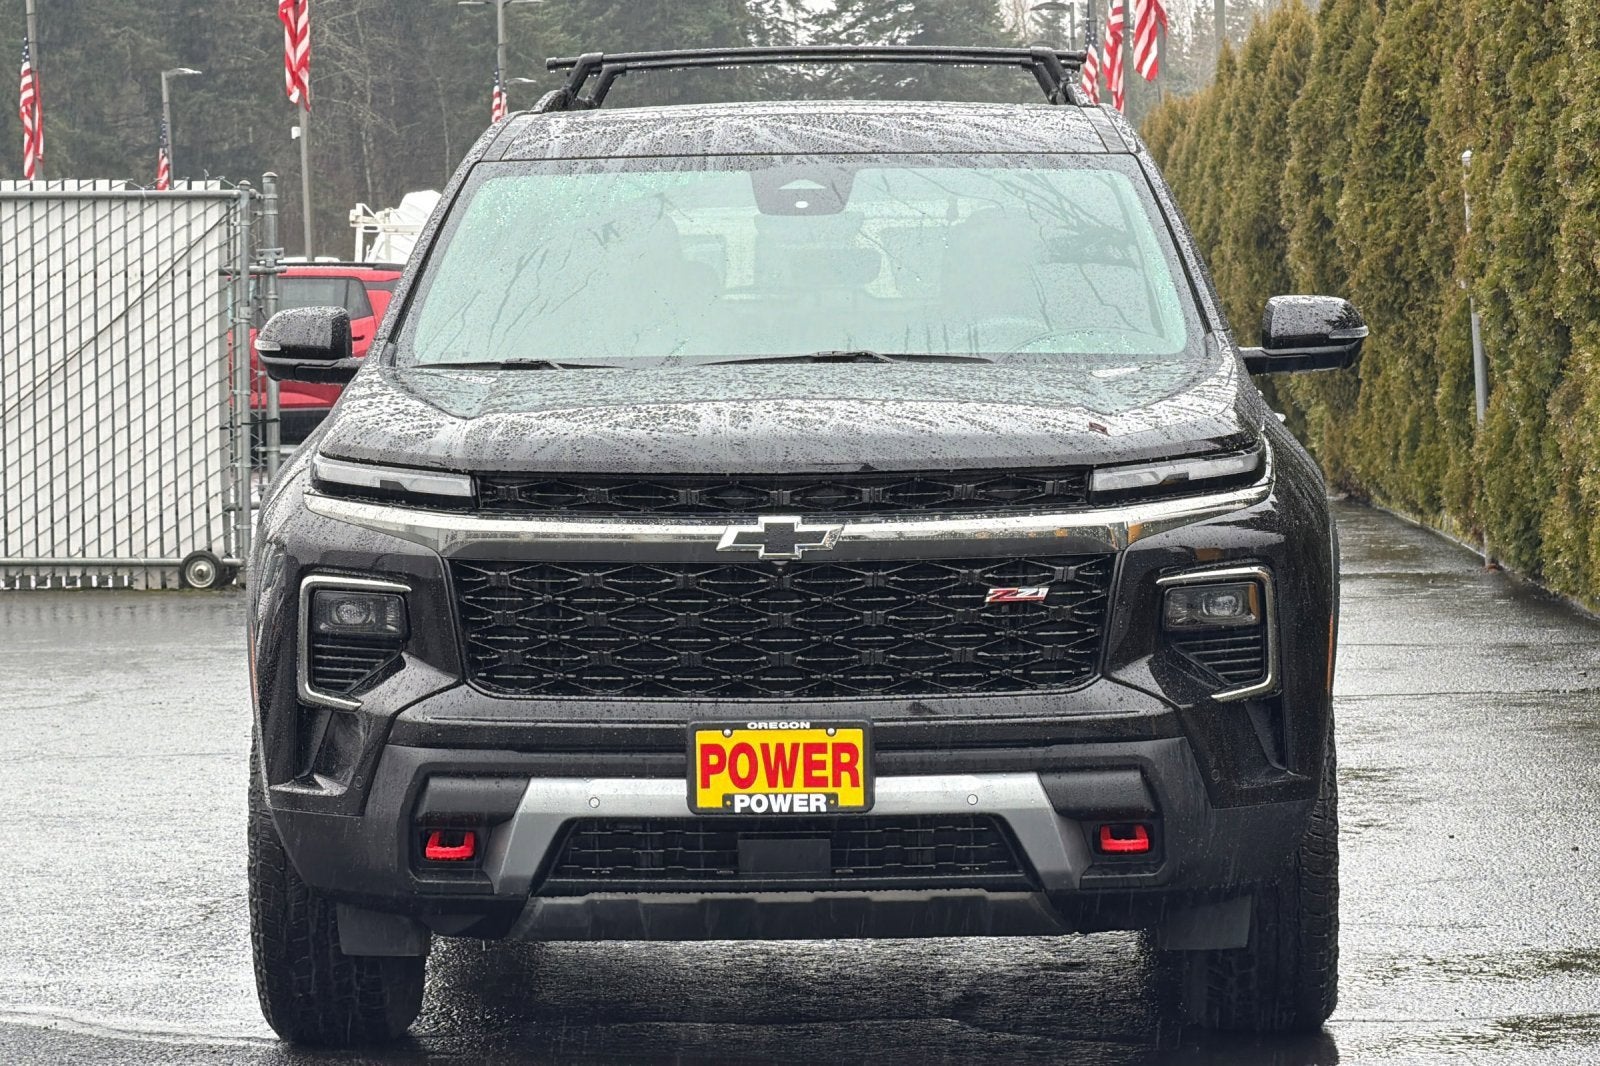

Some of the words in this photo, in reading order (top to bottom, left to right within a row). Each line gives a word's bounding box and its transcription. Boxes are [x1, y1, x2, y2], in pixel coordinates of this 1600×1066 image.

[747, 721, 810, 730] OREGON
[700, 742, 860, 789] POWER
[734, 793, 827, 813] POWER
